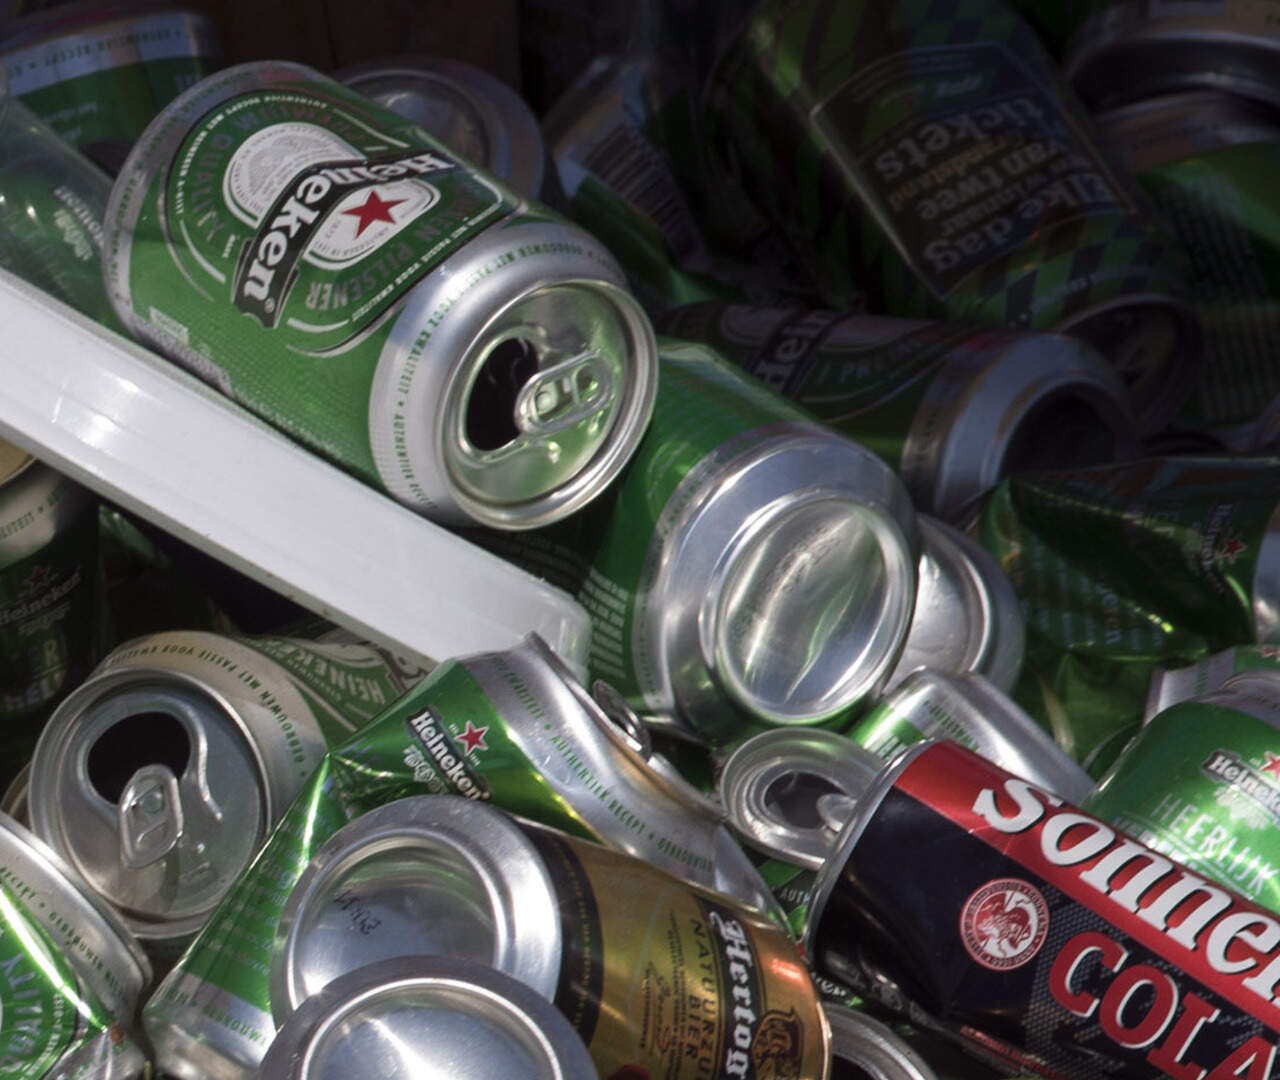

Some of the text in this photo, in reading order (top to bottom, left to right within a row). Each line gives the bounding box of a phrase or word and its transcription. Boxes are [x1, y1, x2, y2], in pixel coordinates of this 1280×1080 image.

[243, 153, 456, 303] Heineken
[922, 215, 1015, 274] dag
[409, 710, 483, 801] Heineken
[685, 992, 703, 1060] BIER
